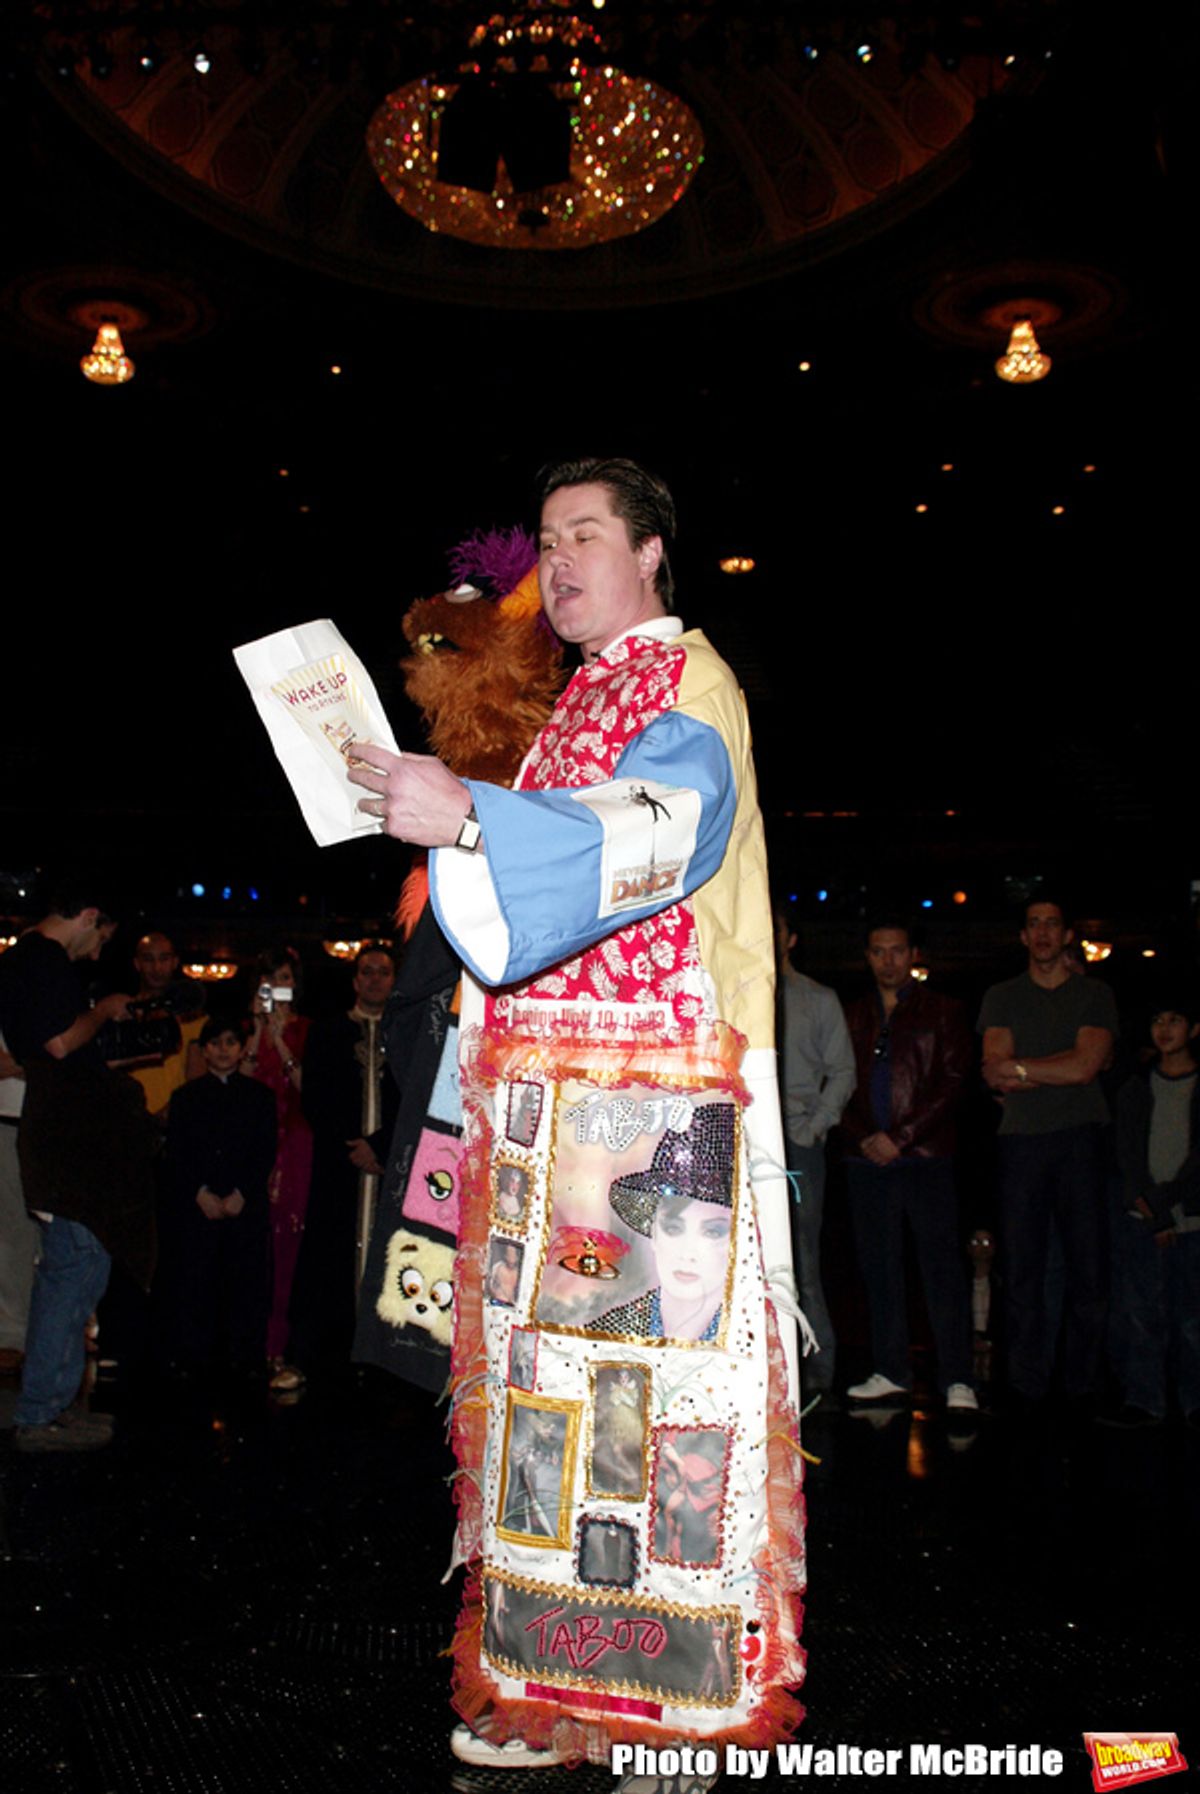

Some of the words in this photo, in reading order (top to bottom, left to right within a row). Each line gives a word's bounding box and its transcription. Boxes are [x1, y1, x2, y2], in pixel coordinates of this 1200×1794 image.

[282, 680, 328, 706] WAKE
[327, 672, 347, 689] UP
[565, 1093, 695, 1151] TABOO
[524, 1606, 668, 1669] TABOO
